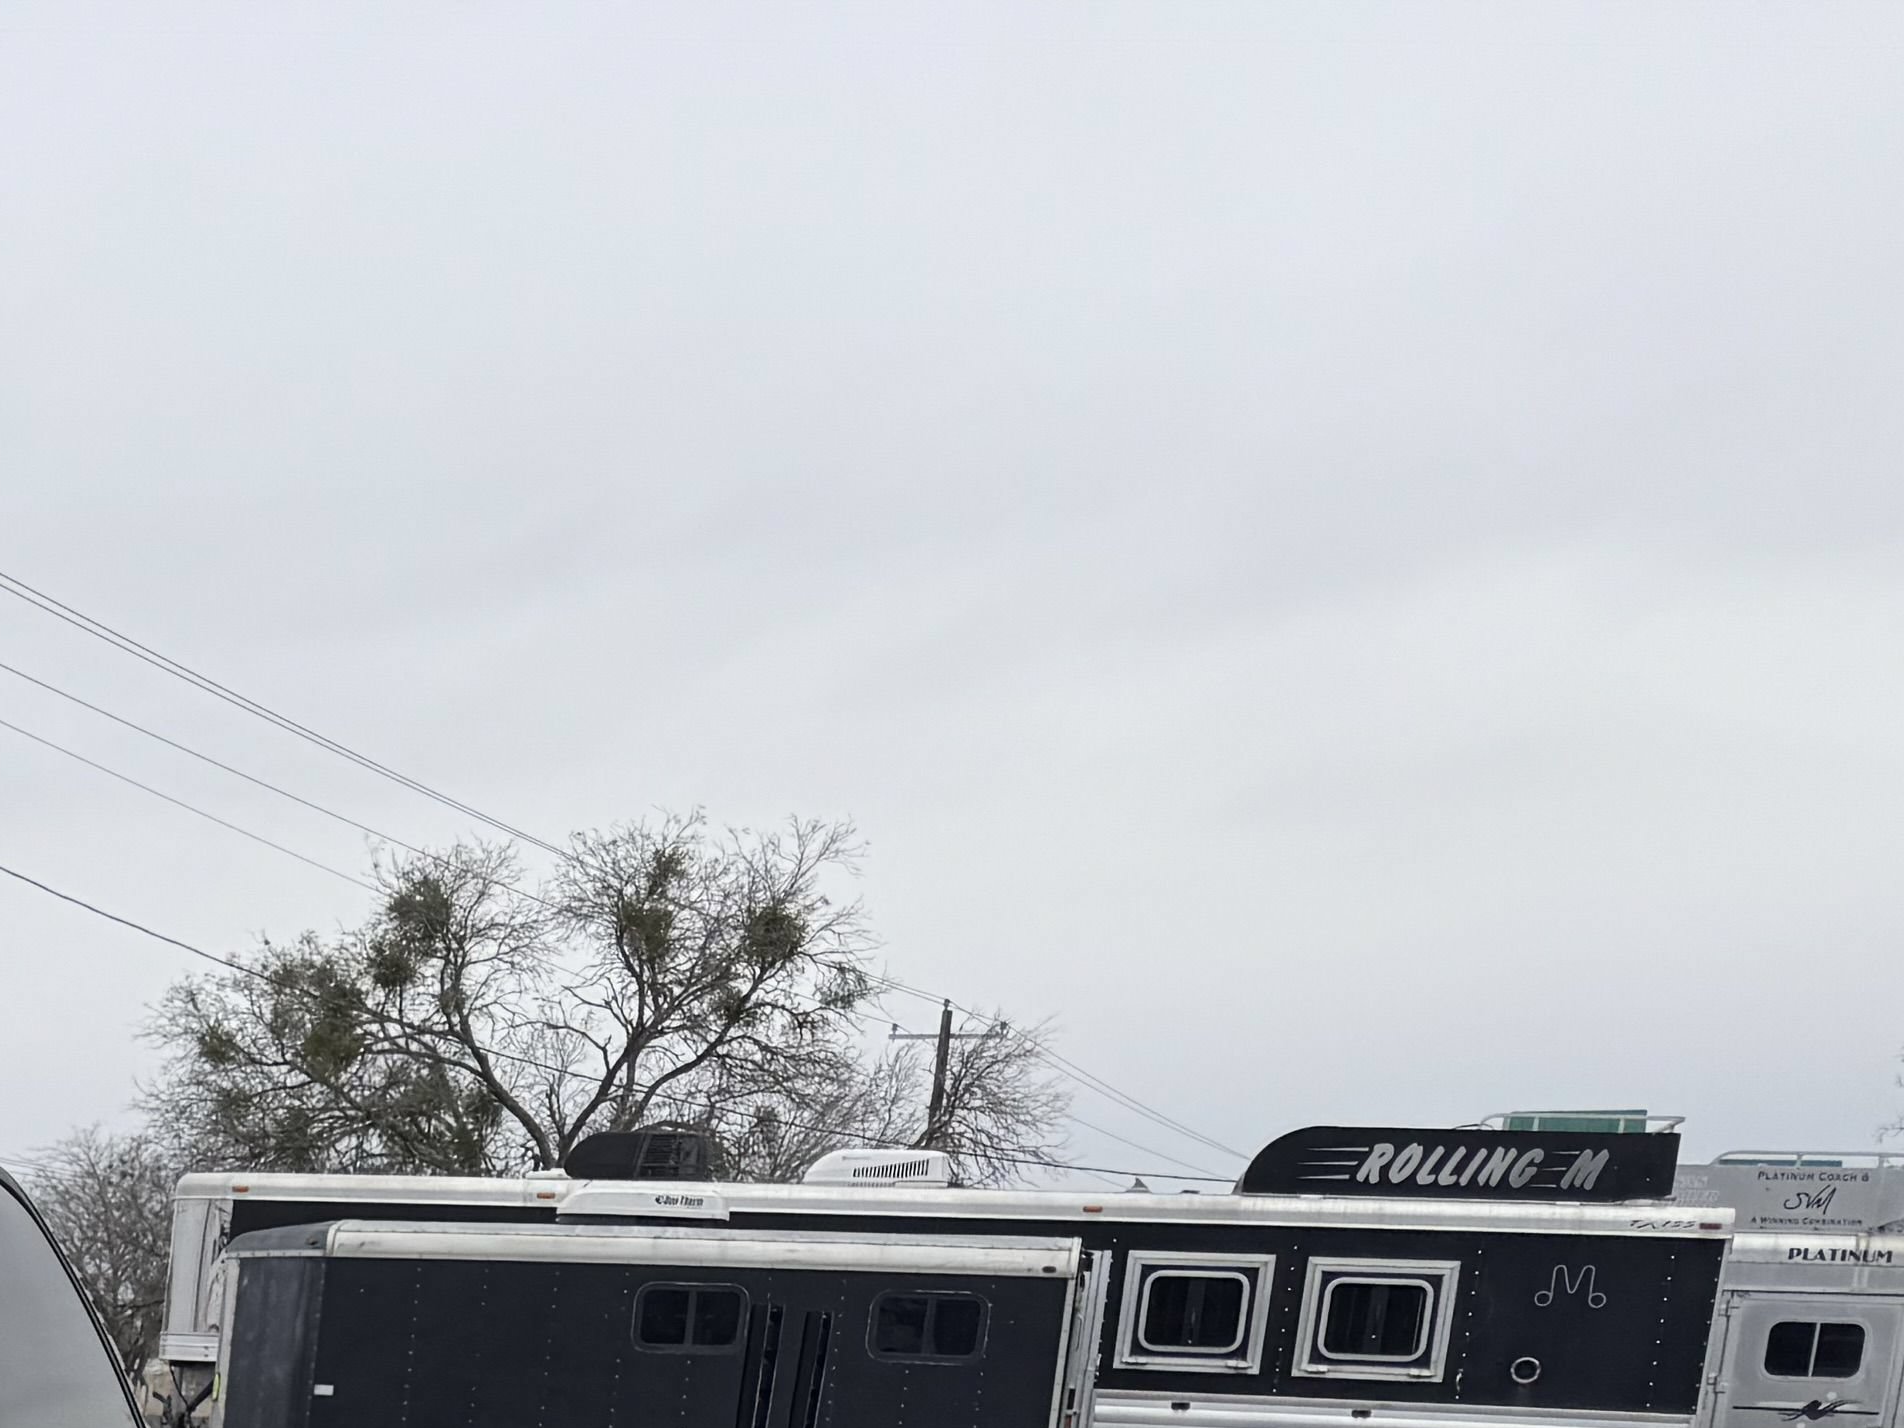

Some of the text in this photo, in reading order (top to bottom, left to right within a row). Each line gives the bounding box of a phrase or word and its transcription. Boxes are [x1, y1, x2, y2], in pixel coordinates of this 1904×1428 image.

[1356, 1142, 1609, 1190] ROLLING M
[1788, 1248, 1893, 1263] PLATINUM
